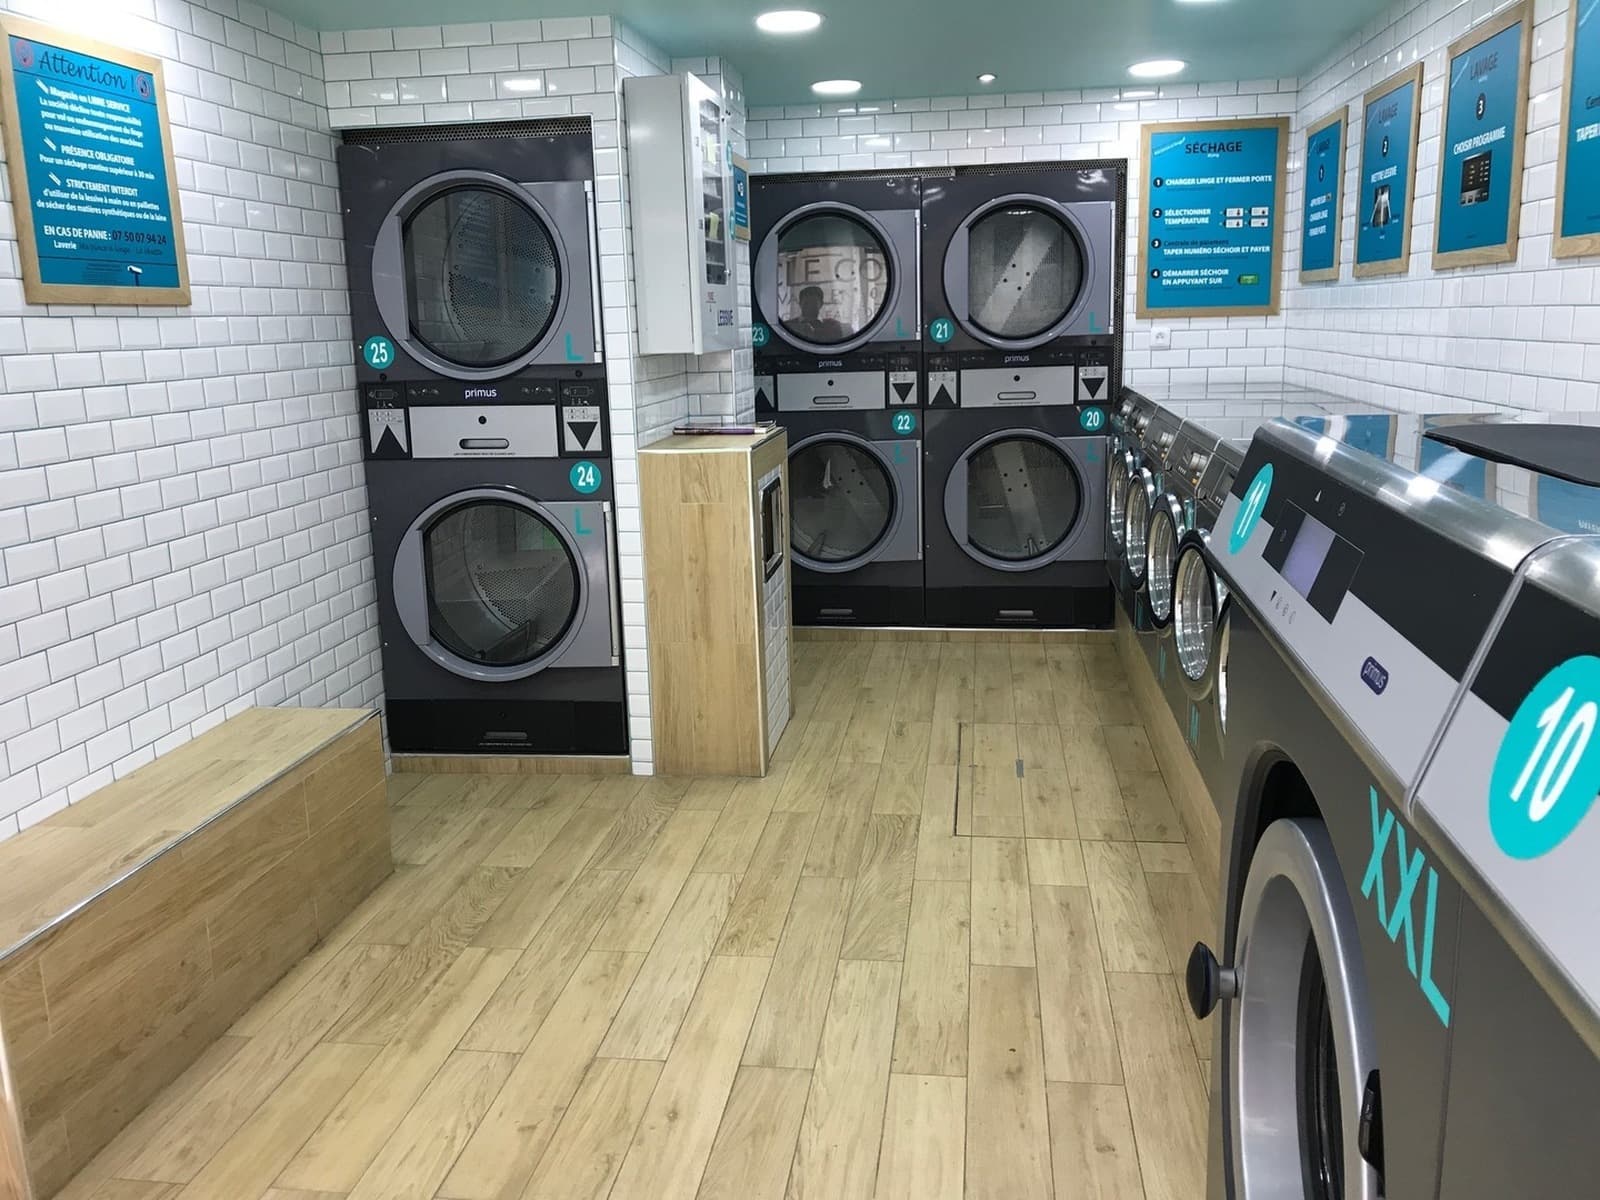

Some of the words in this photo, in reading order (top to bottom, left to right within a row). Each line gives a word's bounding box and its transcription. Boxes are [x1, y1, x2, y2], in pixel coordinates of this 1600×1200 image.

[38, 50, 128, 90] Attention
[130, 73, 135, 92] !
[1478, 98, 1483, 114] 3
[1184, 140, 1241, 153] SÉCHAGE
[65, 178, 109, 192] STRICTEMENT
[110, 185, 138, 196] INTERDIT
[1166, 177, 1195, 185] CHARGER
[1224, 175, 1250, 183] FERMER
[43, 225, 55, 235] EN
[55, 226, 72, 237] CAS
[72, 227, 83, 238] DE
[83, 228, 107, 240] PANNE
[111, 231, 121, 241] 07
[124, 232, 133, 242] 50
[134, 233, 144, 242] 07
[146, 234, 156, 243] 94
[157, 235, 166, 244] 24
[53, 240, 77, 249] Laverie
[896, 317, 910, 337] L
[936, 322, 949, 338] 21
[1089, 312, 1104, 332] L
[751, 327, 764, 342] 23
[371, 342, 388, 363] 25
[565, 333, 583, 361] L
[464, 387, 497, 399] primus
[897, 415, 910, 430] 22
[1086, 411, 1099, 426] 20
[577, 465, 595, 486] 24
[575, 508, 592, 534] L
[1363, 661, 1386, 689] primus
[1509, 686, 1598, 822] 10
[1361, 785, 1450, 1028] XXL
